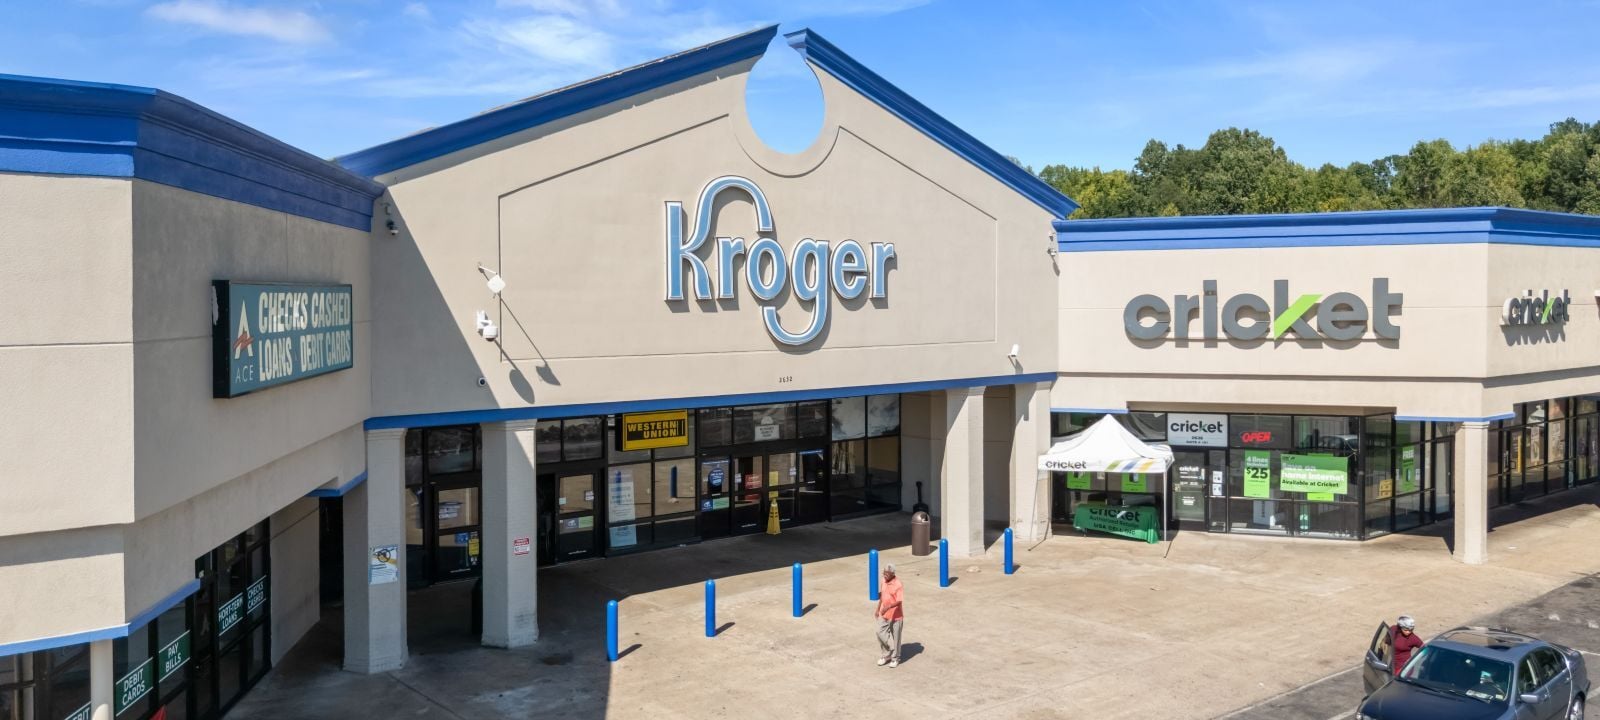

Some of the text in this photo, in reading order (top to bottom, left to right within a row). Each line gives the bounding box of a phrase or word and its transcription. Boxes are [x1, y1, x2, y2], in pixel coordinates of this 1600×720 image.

[664, 175, 895, 345] Kroger
[258, 291, 350, 333] CHECKS CASHED
[1123, 277, 1403, 341] cricket
[258, 329, 351, 382] LOANS DEBIT CARDS
[235, 364, 254, 384] ACE
[627, 420, 677, 432] WESTERN
[643, 428, 677, 439] UNION
[1170, 419, 1223, 433] cricket
[1241, 432, 1271, 442] OPEN
[1045, 460, 1087, 469] cricket
[1246, 467, 1268, 479] $25
[247, 580, 264, 599] CHECKS
[218, 596, 244, 622] HORT-TER
[247, 590, 264, 610] CASHED
[222, 610, 238, 630] LOANS
[167, 641, 179, 660] PAY
[165, 653, 182, 674] BILLS
[123, 668, 144, 693] DEBIT
[122, 680, 146, 706] CARDS
